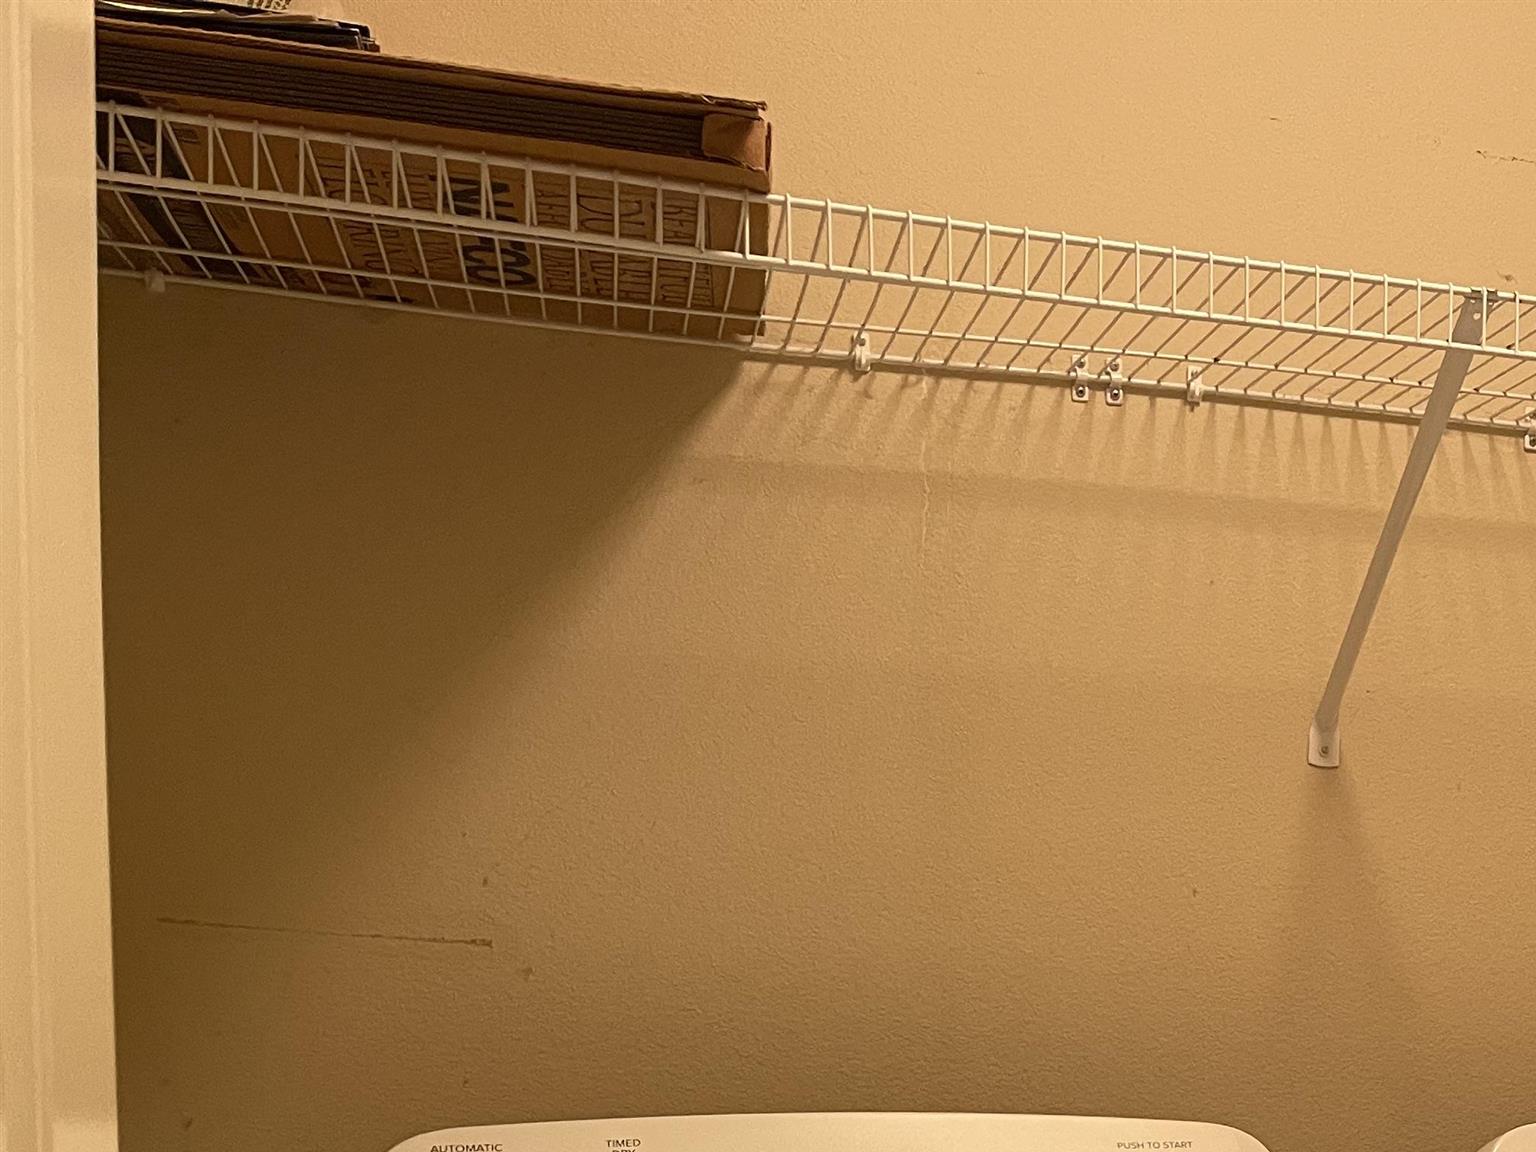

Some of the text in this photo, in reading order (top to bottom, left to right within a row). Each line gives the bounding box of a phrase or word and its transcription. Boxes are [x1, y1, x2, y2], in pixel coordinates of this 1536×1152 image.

[312, 162, 420, 275] FLORING
[532, 188, 591, 294] AFFDABLE
[575, 193, 652, 301] DUABLE
[606, 1138, 641, 1148] TIMED
[1117, 1140, 1193, 1150] PUSH TO START
